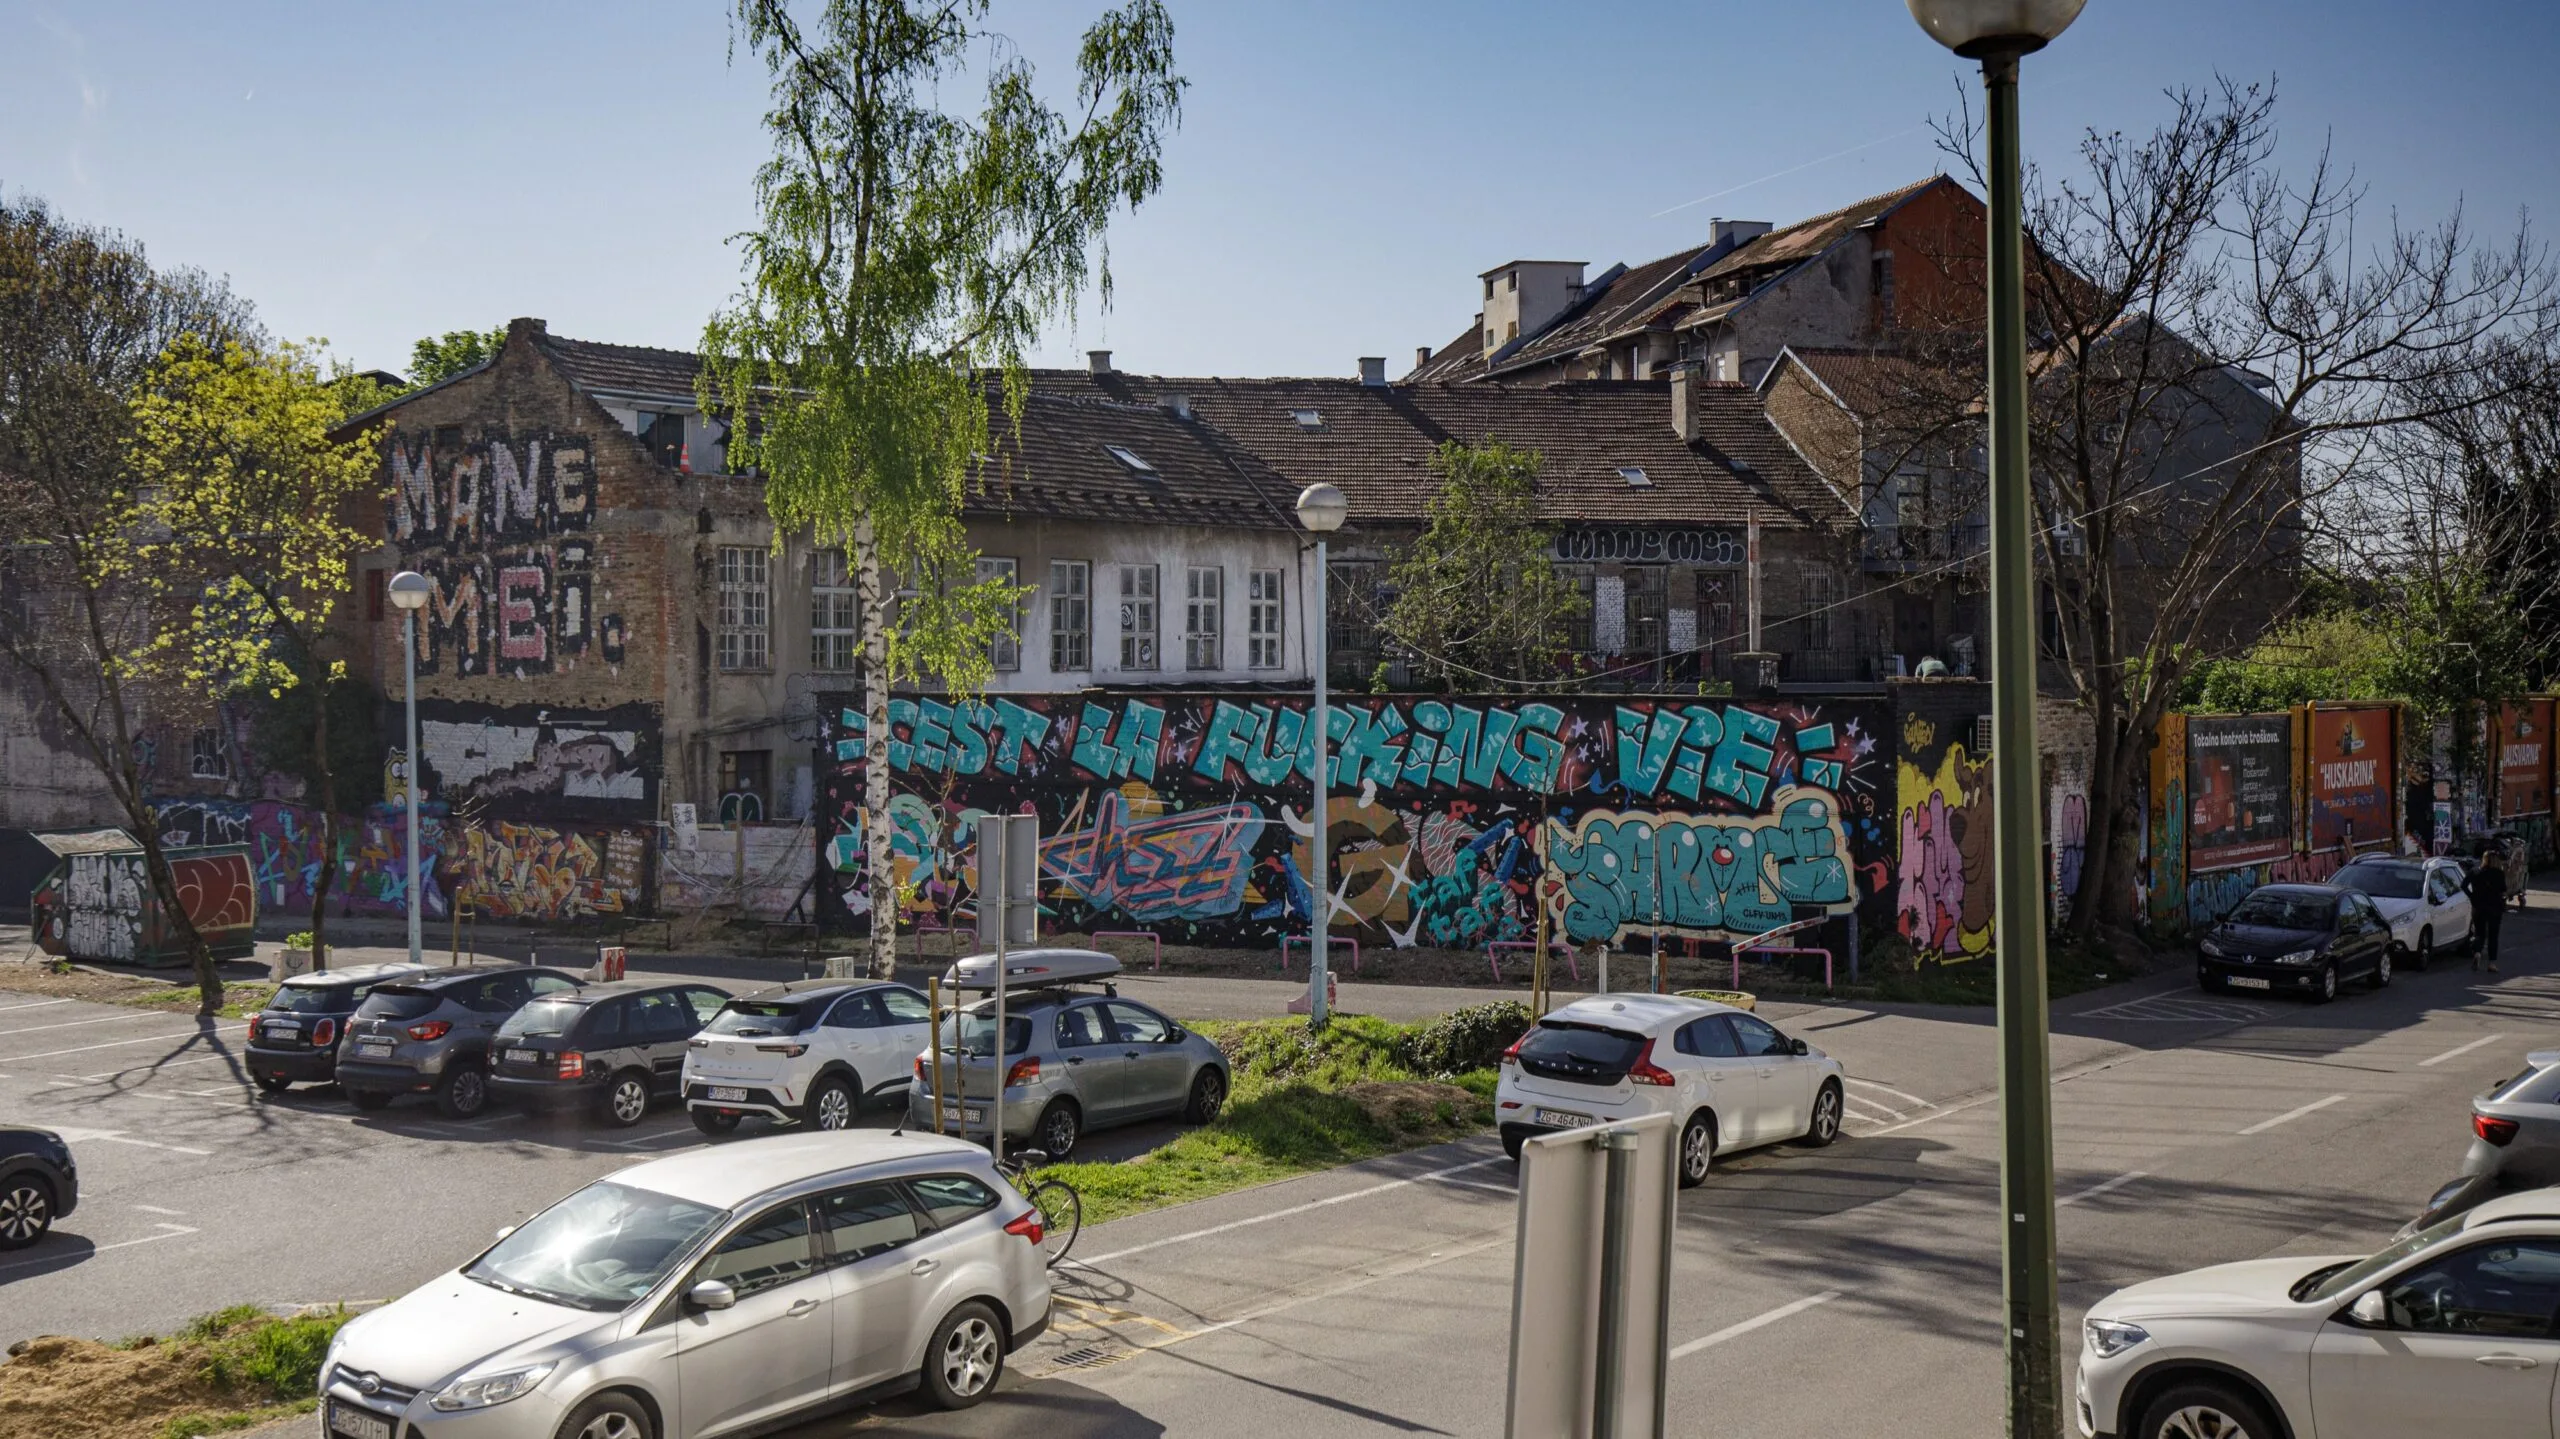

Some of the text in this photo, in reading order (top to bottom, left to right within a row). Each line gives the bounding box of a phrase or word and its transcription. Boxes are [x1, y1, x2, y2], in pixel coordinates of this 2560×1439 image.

[1071, 699, 1166, 784] LA
[2193, 732, 2219, 748] Totalna
[2220, 730, 2248, 746] kontrola
[1540, 1111, 1551, 1123] ZG
